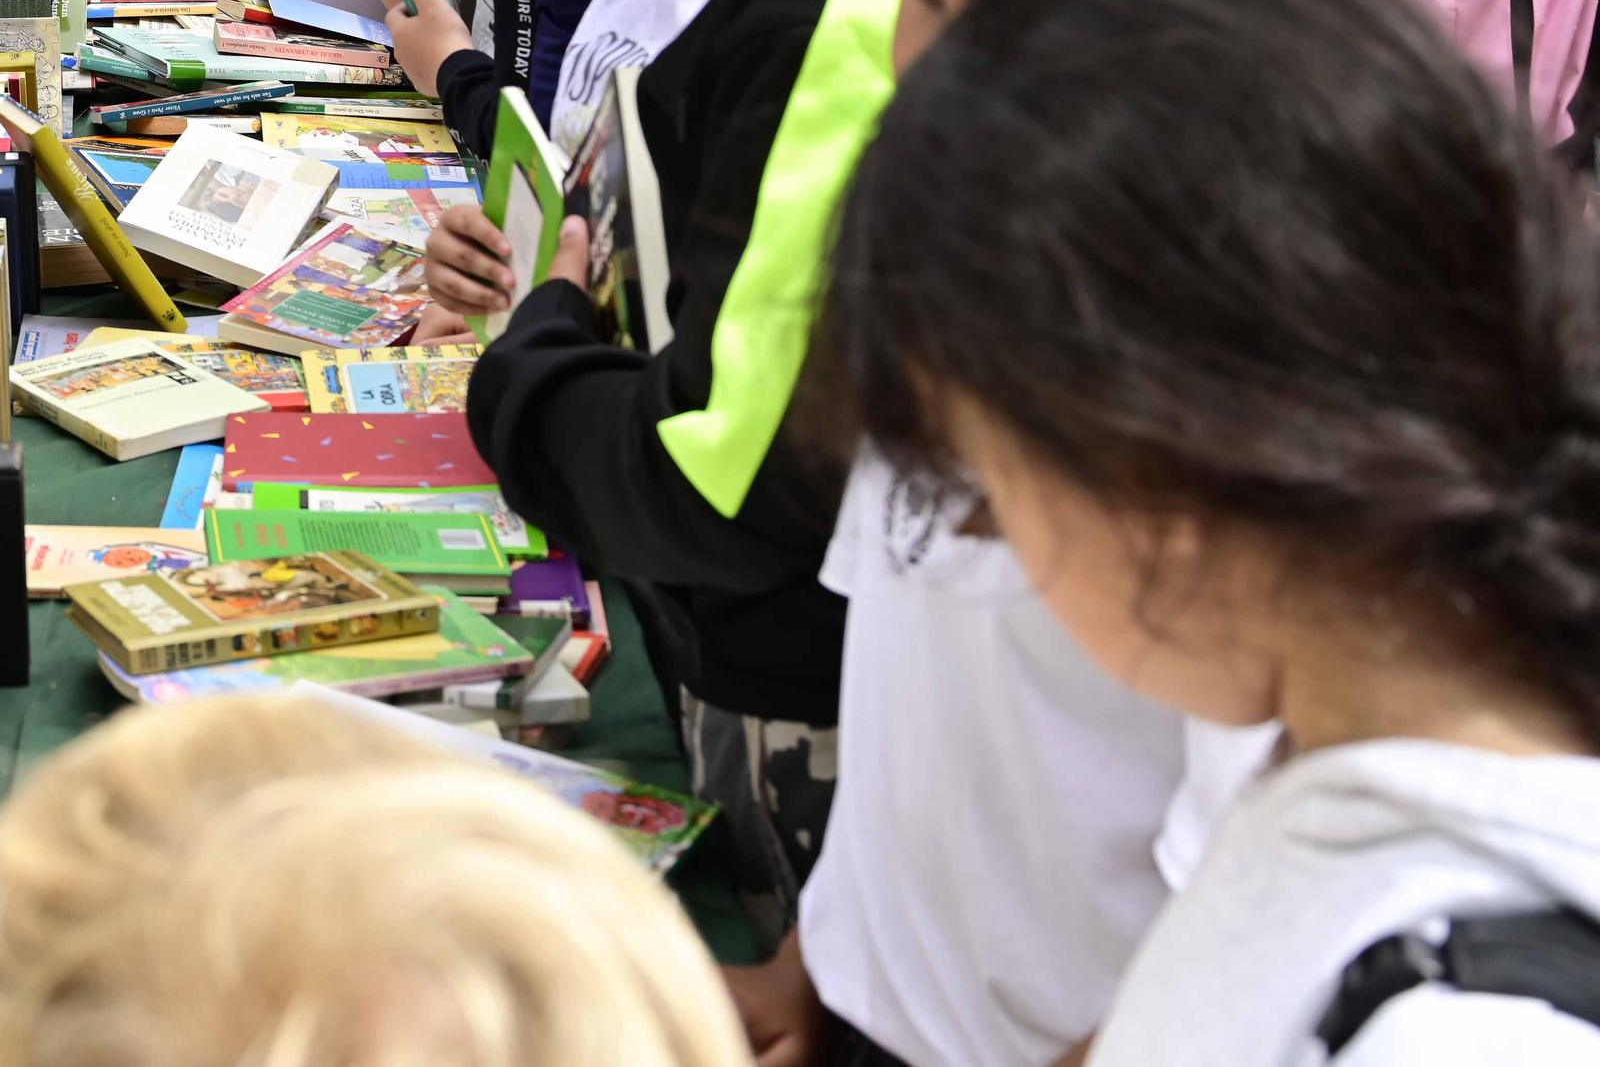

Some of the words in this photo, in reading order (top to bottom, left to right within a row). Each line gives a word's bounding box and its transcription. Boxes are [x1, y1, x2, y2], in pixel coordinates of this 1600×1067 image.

[61, 0, 70, 18] Juan
[274, 46, 309, 55] CERVANTES
[319, 50, 343, 59] MIGUEL
[514, 28, 531, 78] TODAY
